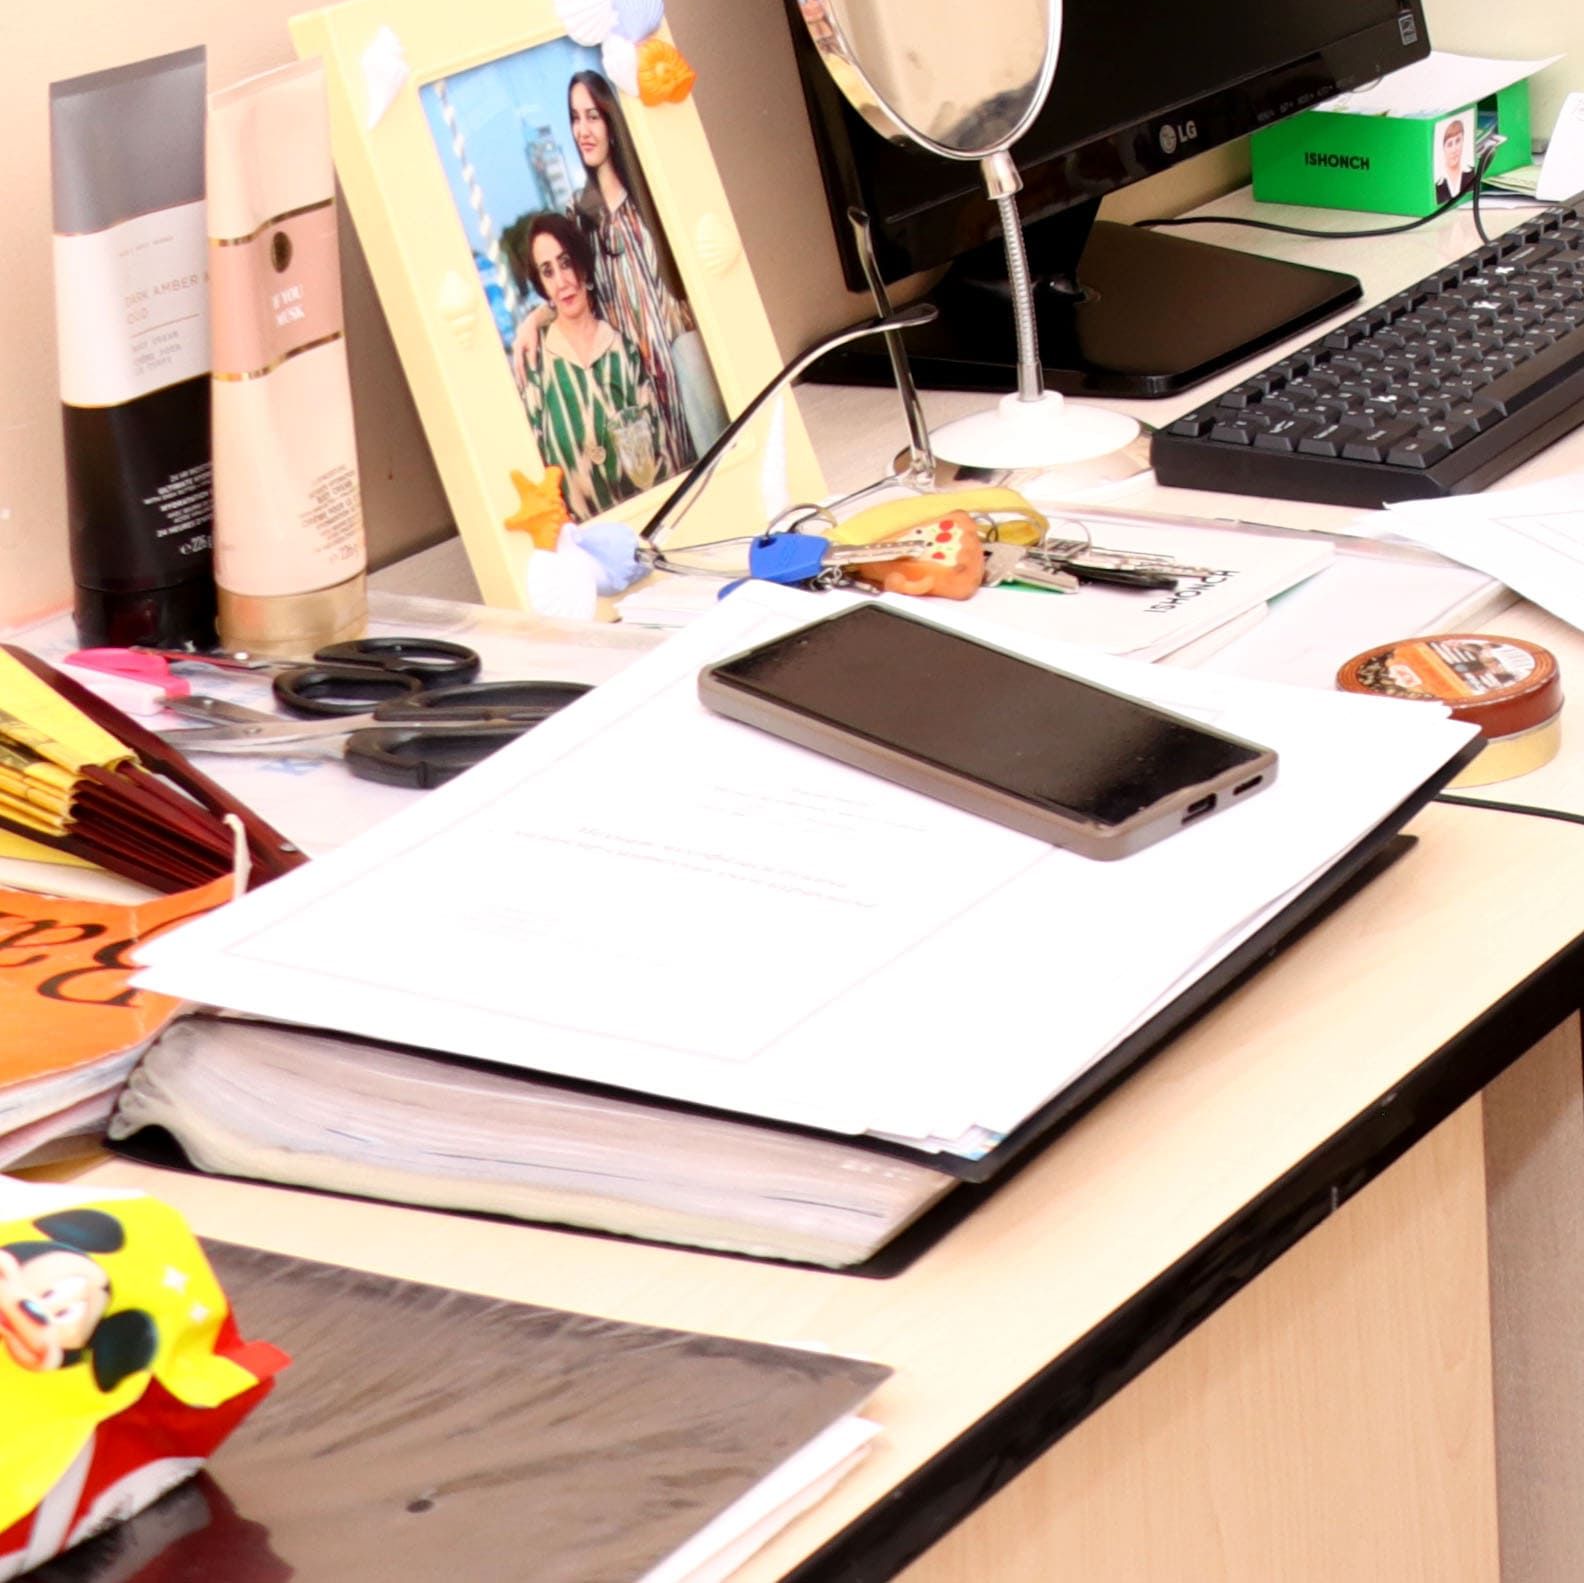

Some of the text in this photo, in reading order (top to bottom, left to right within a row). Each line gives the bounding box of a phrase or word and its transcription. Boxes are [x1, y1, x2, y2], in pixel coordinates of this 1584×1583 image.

[1177, 120, 1199, 144] LG
[1304, 151, 1370, 171] ISHONCH
[153, 273, 199, 295] AMBER
[1143, 569, 1241, 614] ISHONCH
